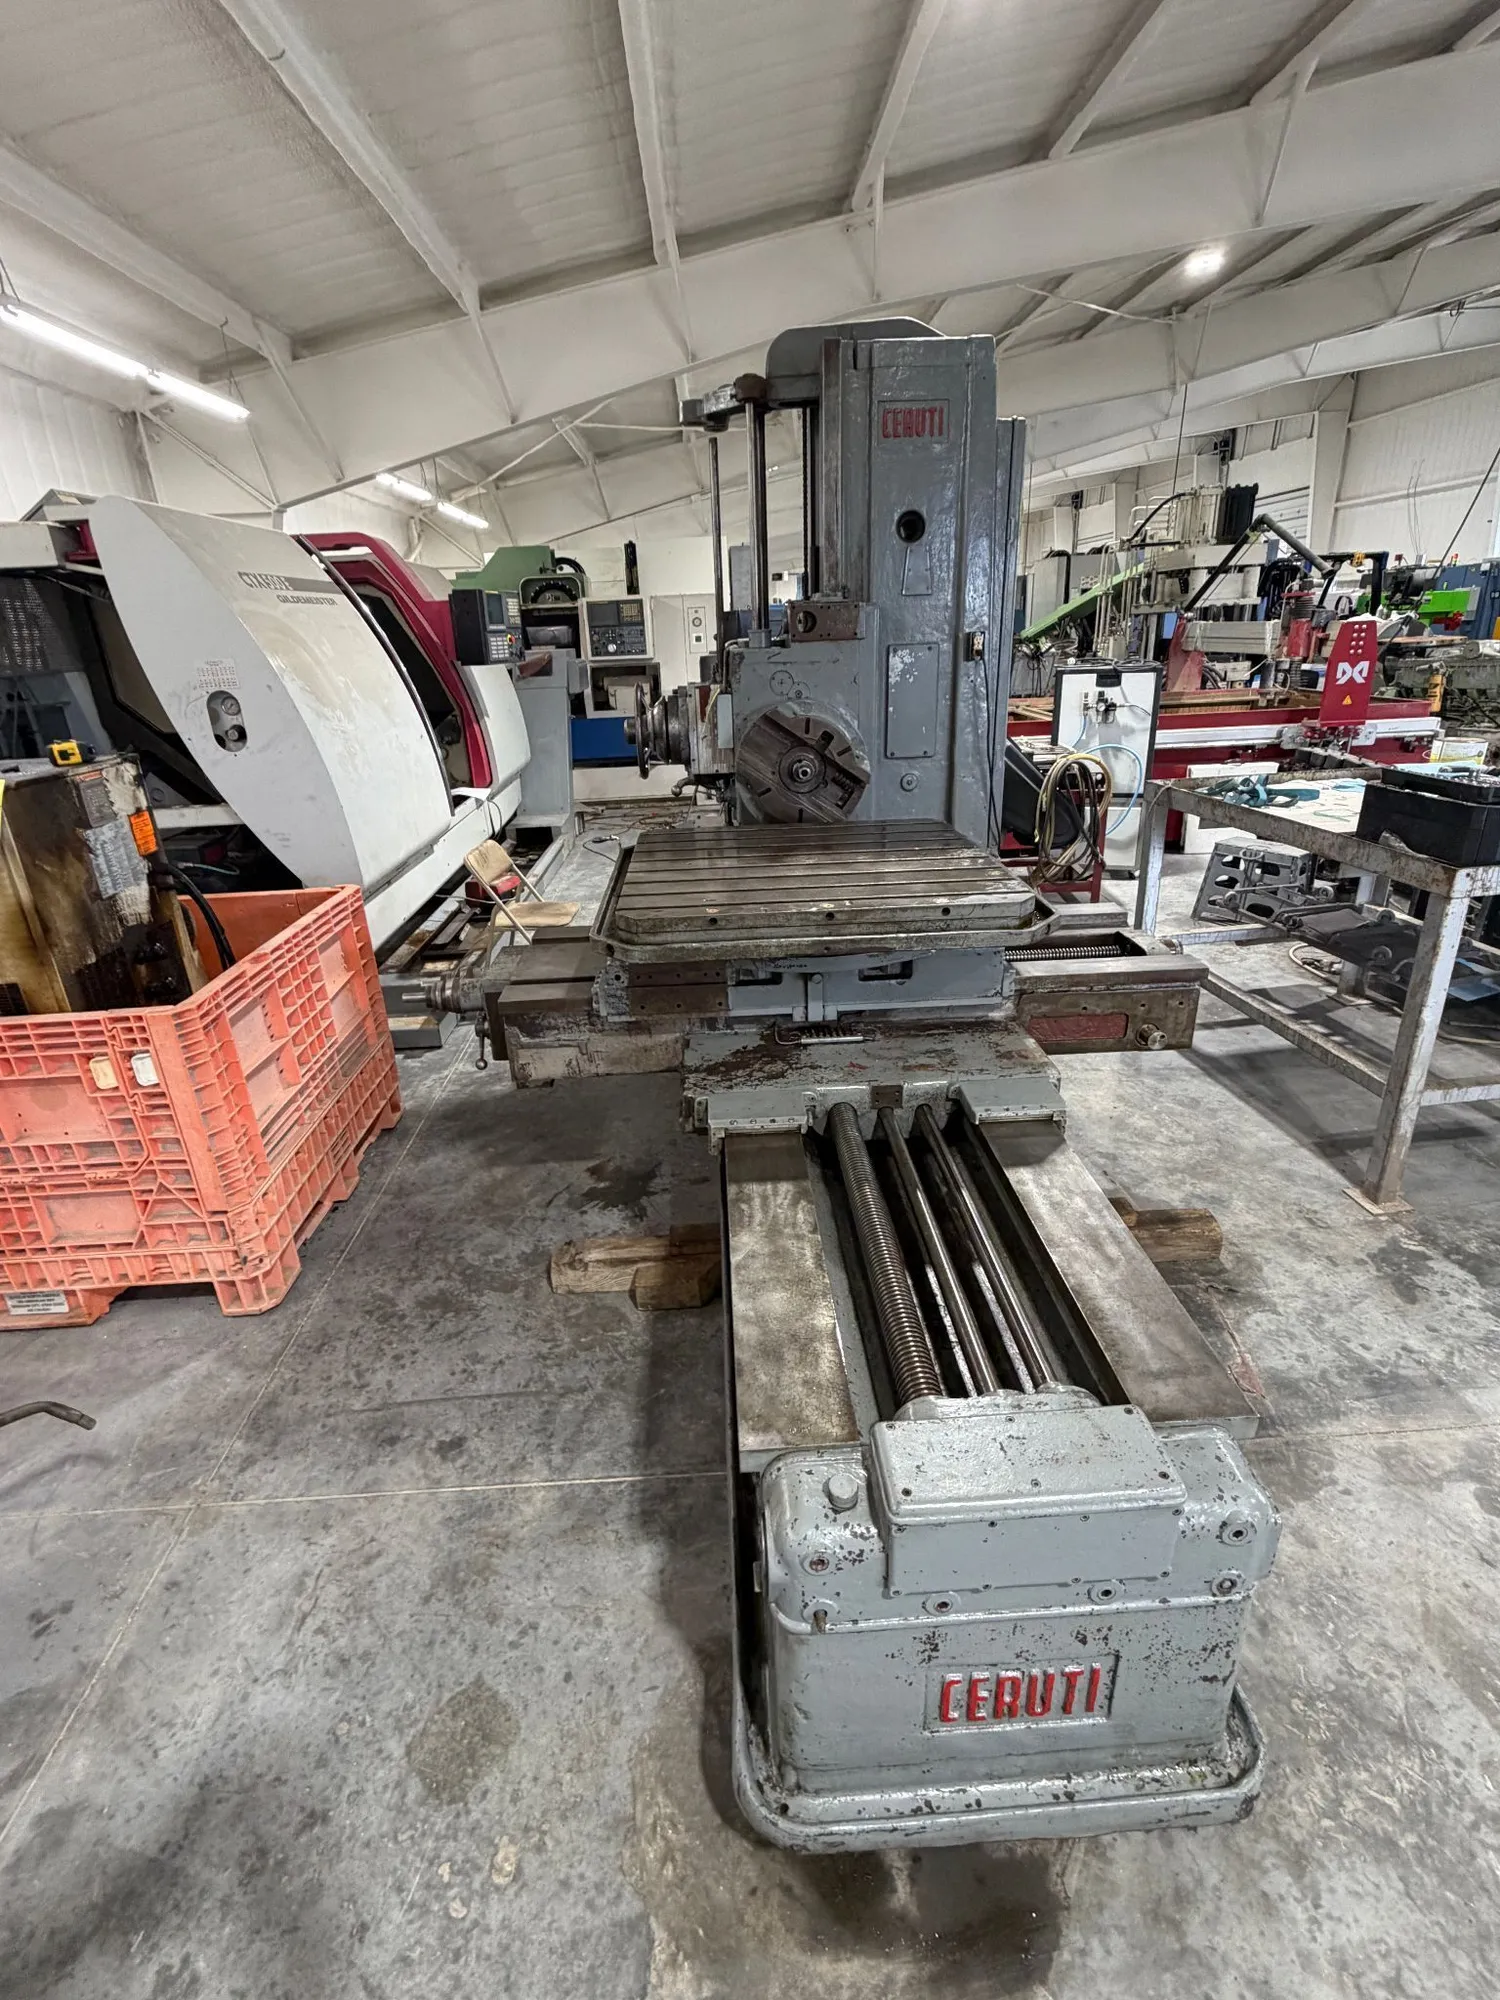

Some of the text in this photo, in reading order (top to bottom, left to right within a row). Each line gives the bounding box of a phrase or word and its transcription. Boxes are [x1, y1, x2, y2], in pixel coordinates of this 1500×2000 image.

[882, 406, 944, 439] CERUTI
[276, 594, 338, 605] GILDEMEISTER
[938, 1662, 1102, 1723] CERUTI
